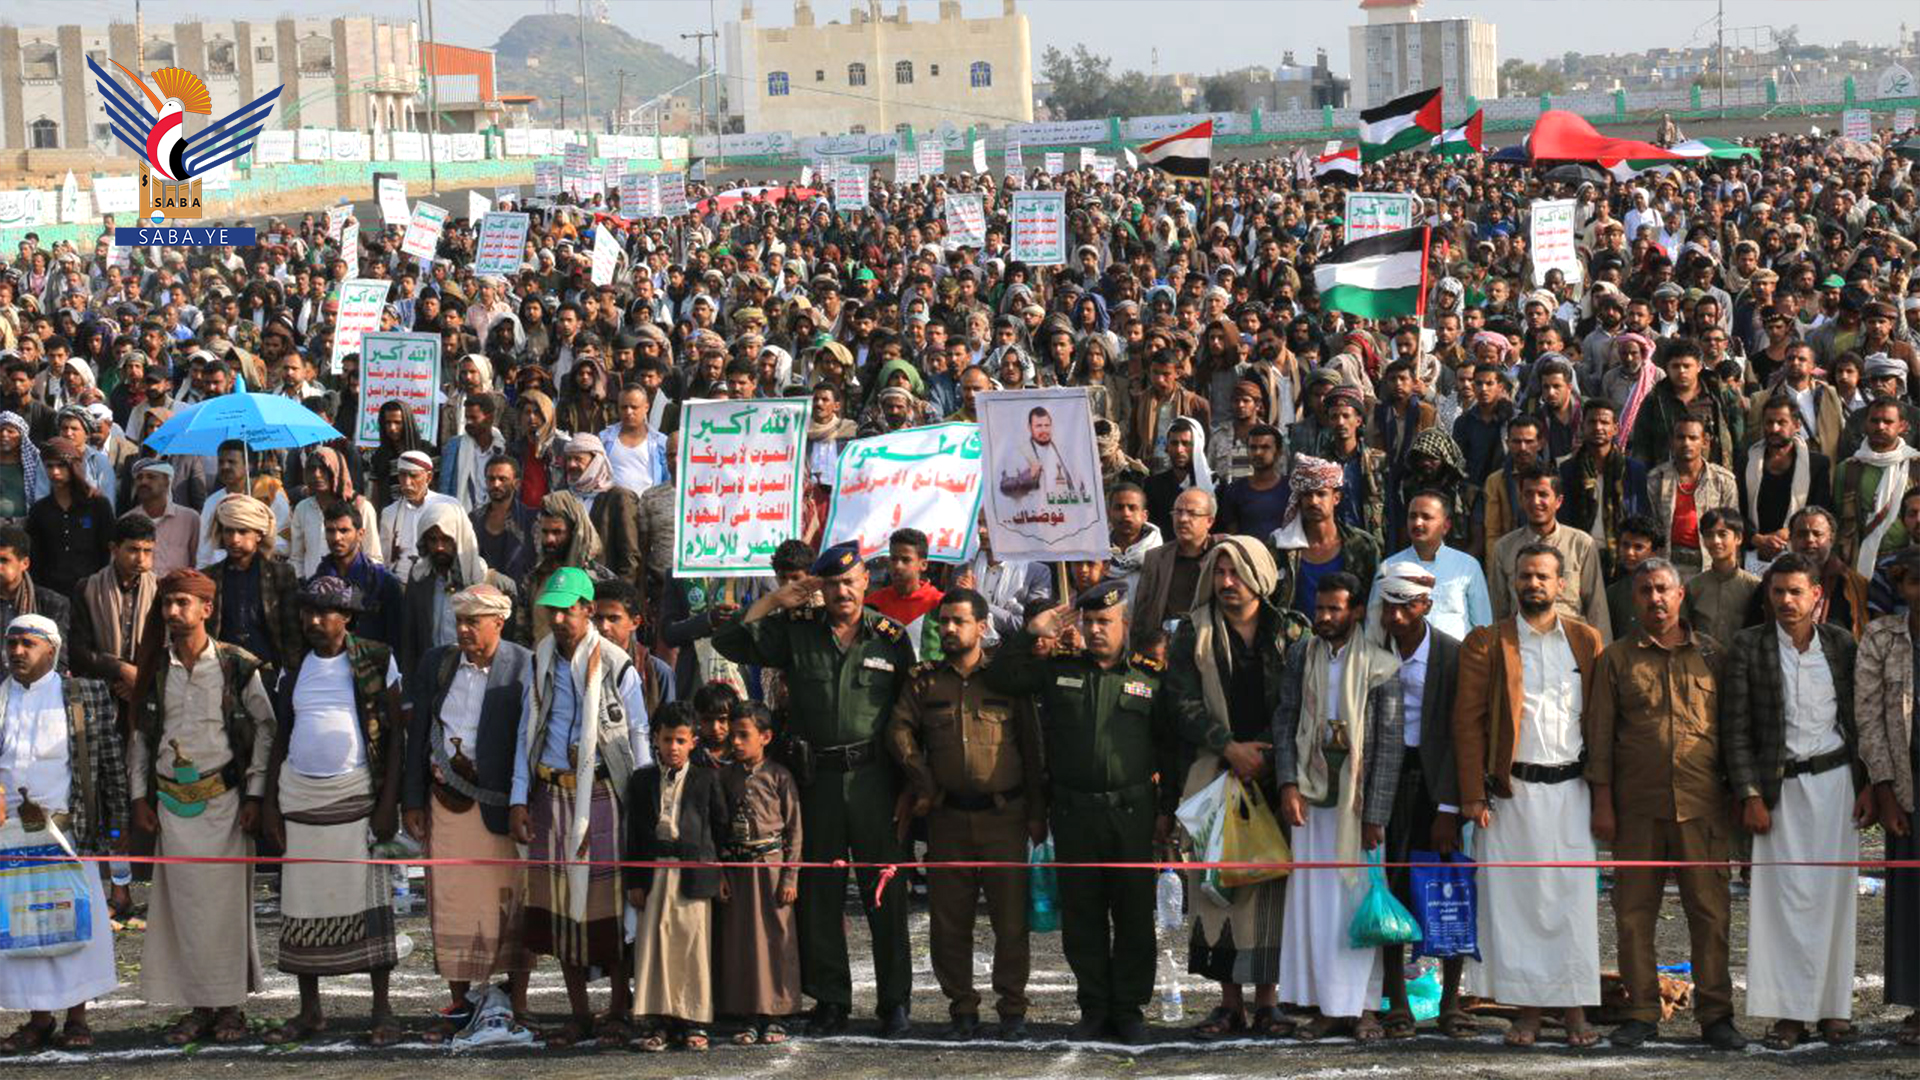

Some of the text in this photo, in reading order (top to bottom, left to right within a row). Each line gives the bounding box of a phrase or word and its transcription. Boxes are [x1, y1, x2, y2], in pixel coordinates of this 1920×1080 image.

[407, 345, 433, 361] الله
[692, 405, 802, 443] الله أكبر
[749, 444, 794, 467] الموت
[748, 473, 792, 496] الموت
[685, 501, 790, 528] اللعنة على اليهود
[890, 504, 901, 528] و
